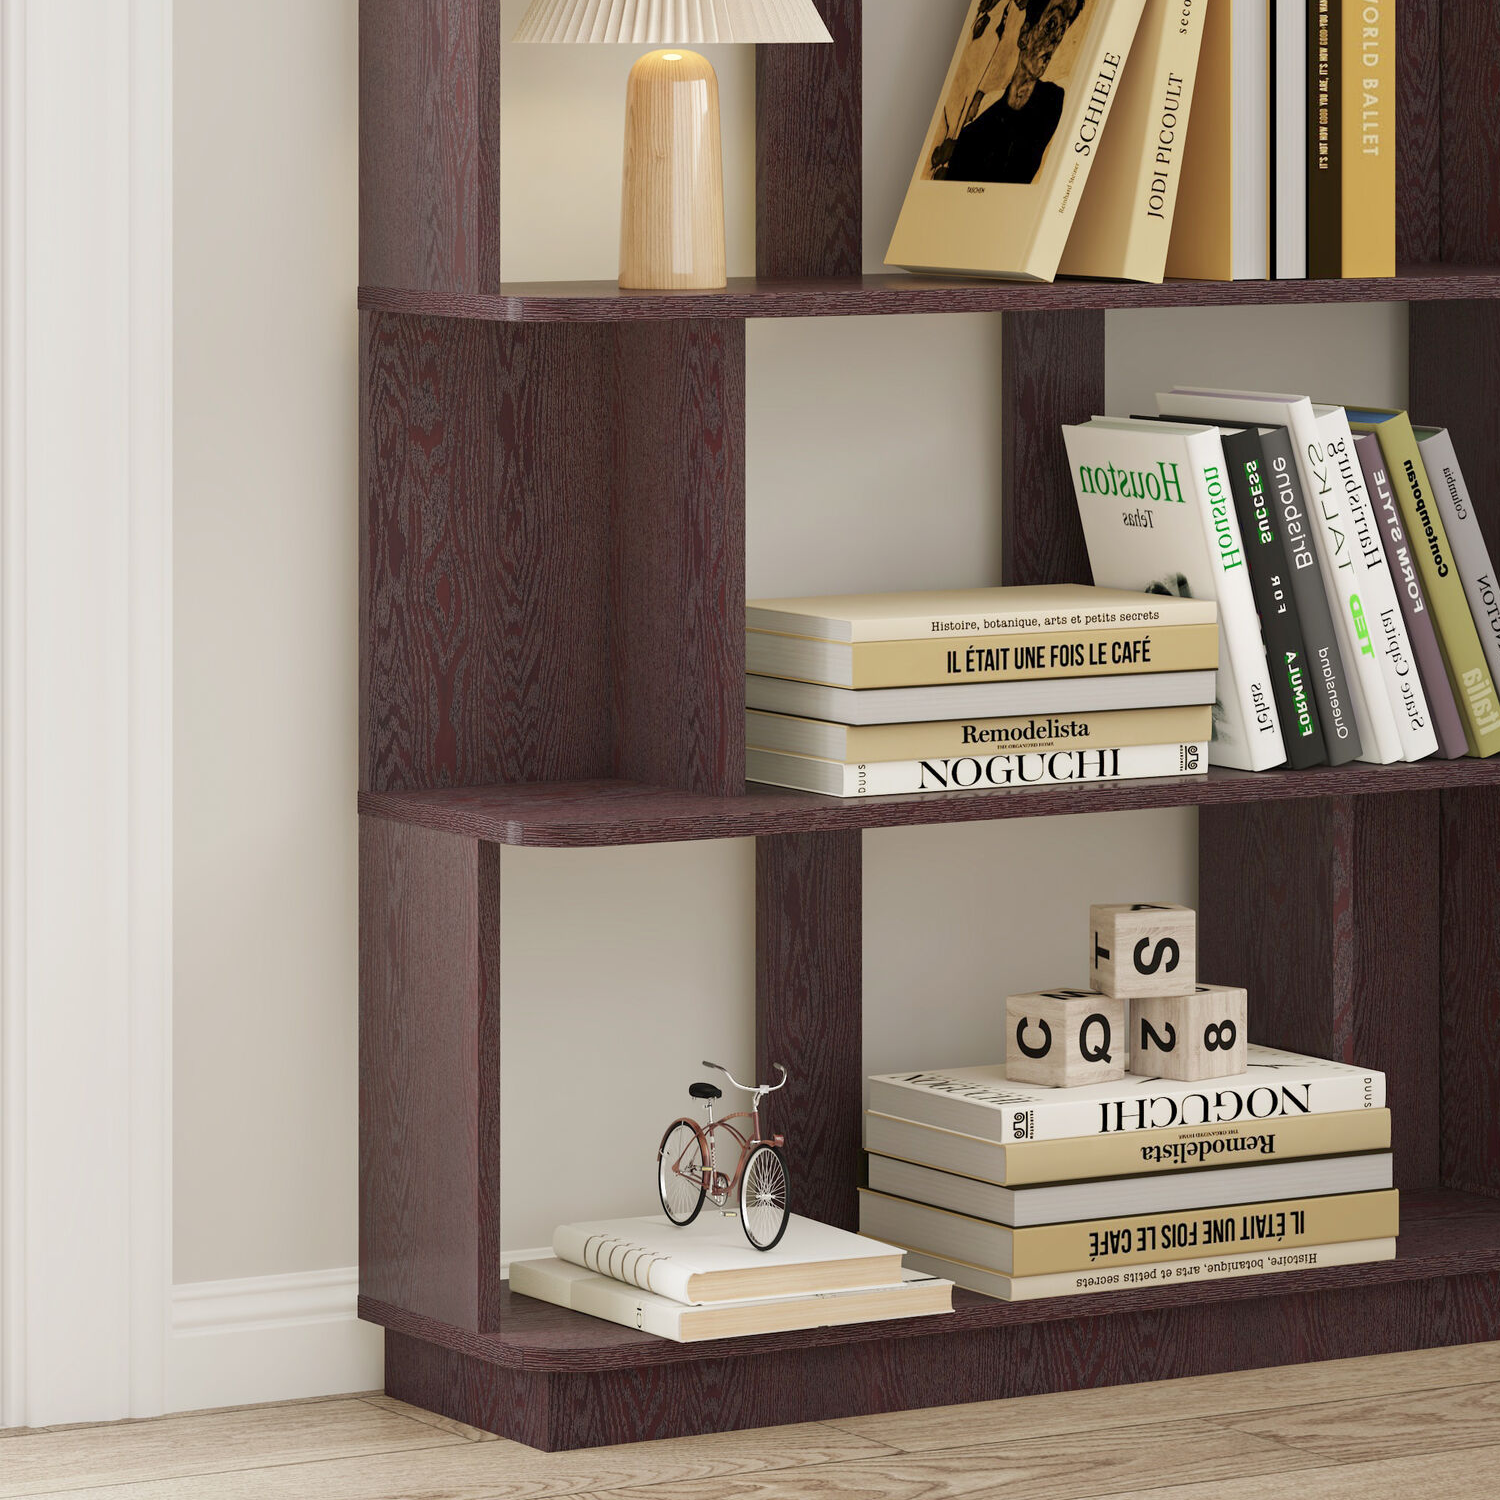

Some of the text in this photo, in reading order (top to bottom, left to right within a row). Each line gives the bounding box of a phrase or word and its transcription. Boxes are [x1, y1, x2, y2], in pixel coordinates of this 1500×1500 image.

[1074, 52, 1121, 157] SCHIELE
[1362, 78, 1379, 156] BALLET
[1147, 72, 1184, 220] JODI PICOULT
[931, 609, 1160, 632] Histoire, botanique, arts et petits secrets
[946, 635, 1152, 674] IL ÉTAIT UNE FOIS LE CAFÉ
[960, 718, 1091, 745] Remodelista
[917, 747, 1122, 790] NOGUCHI
[1132, 935, 1180, 976] S
[1015, 1015, 1053, 1059] C
[1078, 1012, 1112, 1064] Q
[1140, 1018, 1177, 1053] 2
[1203, 1019, 1237, 1052] 8
[1098, 1083, 1312, 1134] NOGUCHI
[1141, 1134, 1276, 1164] Remodelista
[1089, 1210, 1305, 1262] IL ÉTAIT UNE FOIS LE CAFÉ
